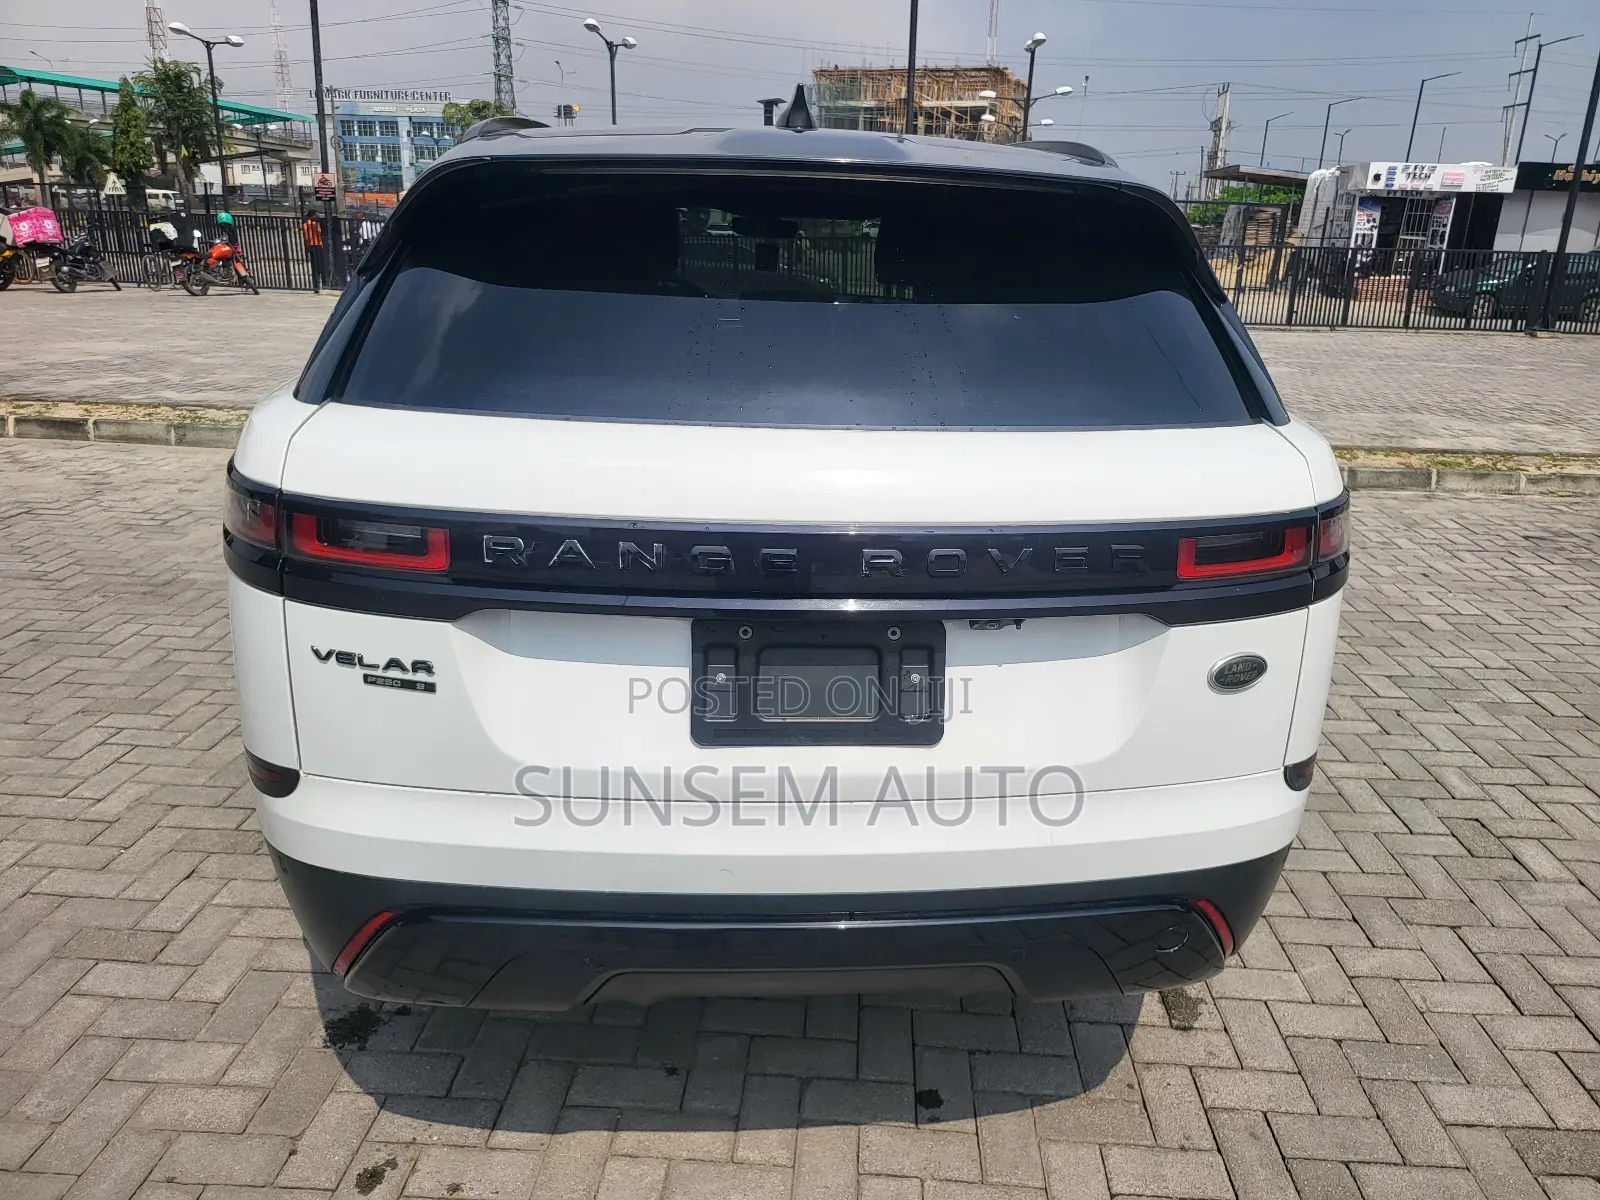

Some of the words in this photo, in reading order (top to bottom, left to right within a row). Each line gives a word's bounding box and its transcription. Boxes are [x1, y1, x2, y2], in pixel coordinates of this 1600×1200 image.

[309, 89, 351, 100] LMARK
[354, 89, 410, 101] FURNITURE
[412, 91, 452, 102] CENTER
[483, 534, 798, 573] RANGE
[861, 544, 1148, 577] ROVER
[311, 645, 435, 675] VELAR
[1223, 662, 1251, 674] LAND
[367, 676, 401, 687] P250
[1225, 671, 1258, 684] ROVER
